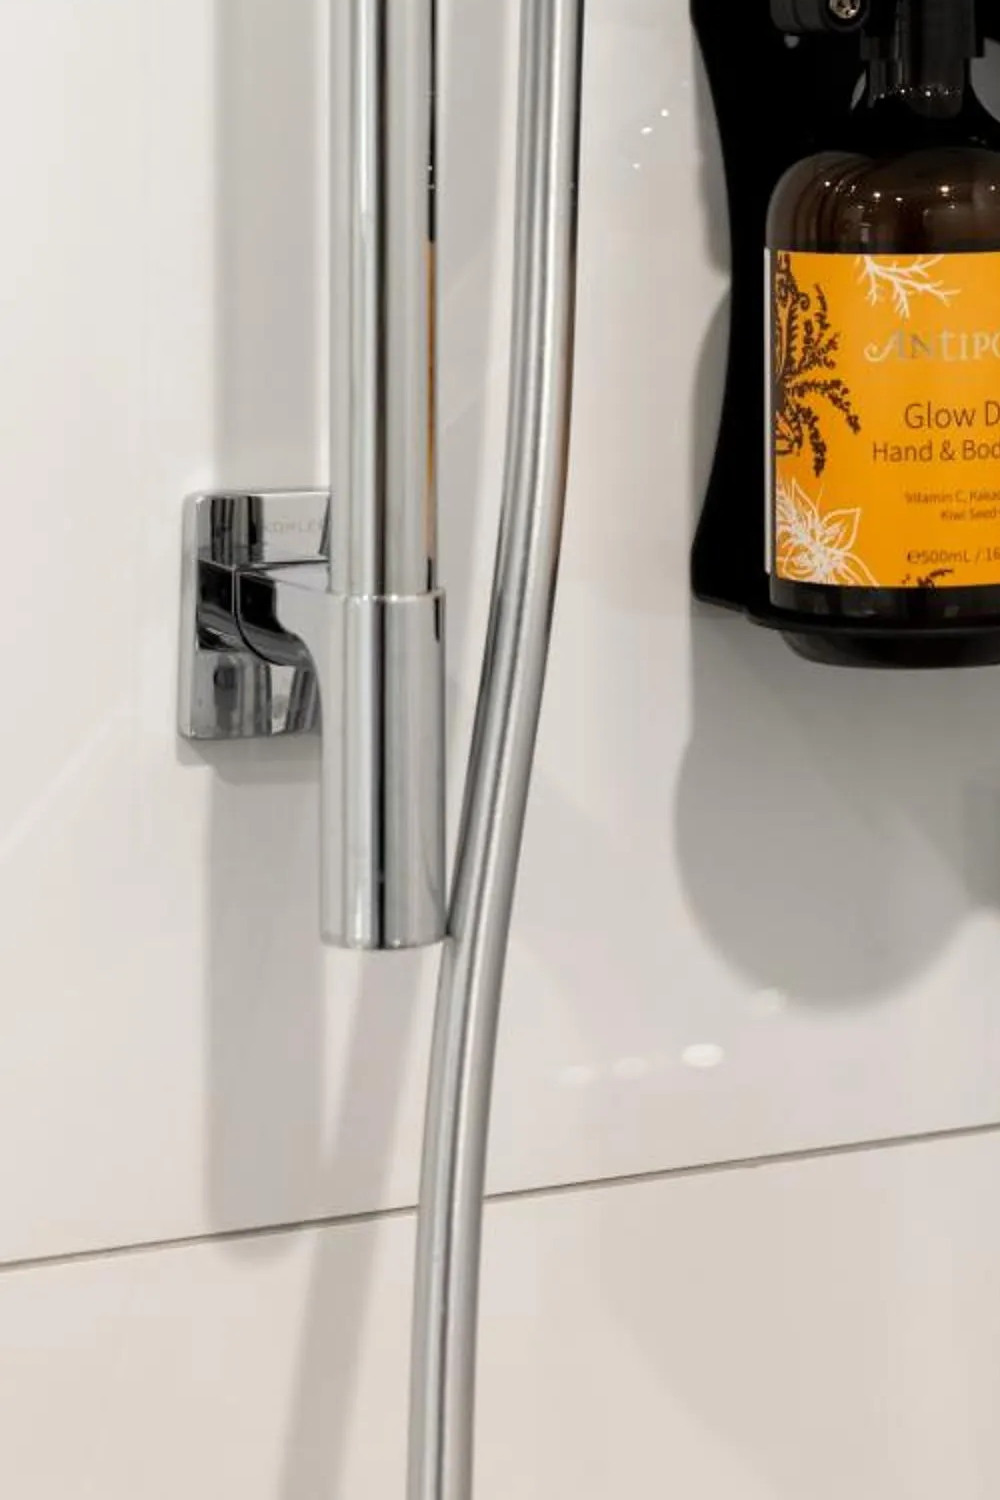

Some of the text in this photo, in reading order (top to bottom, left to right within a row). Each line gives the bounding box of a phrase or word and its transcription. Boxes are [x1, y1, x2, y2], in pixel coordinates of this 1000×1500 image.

[903, 401, 976, 430] Glow
[872, 438, 933, 463] Hand
[939, 438, 957, 462] &
